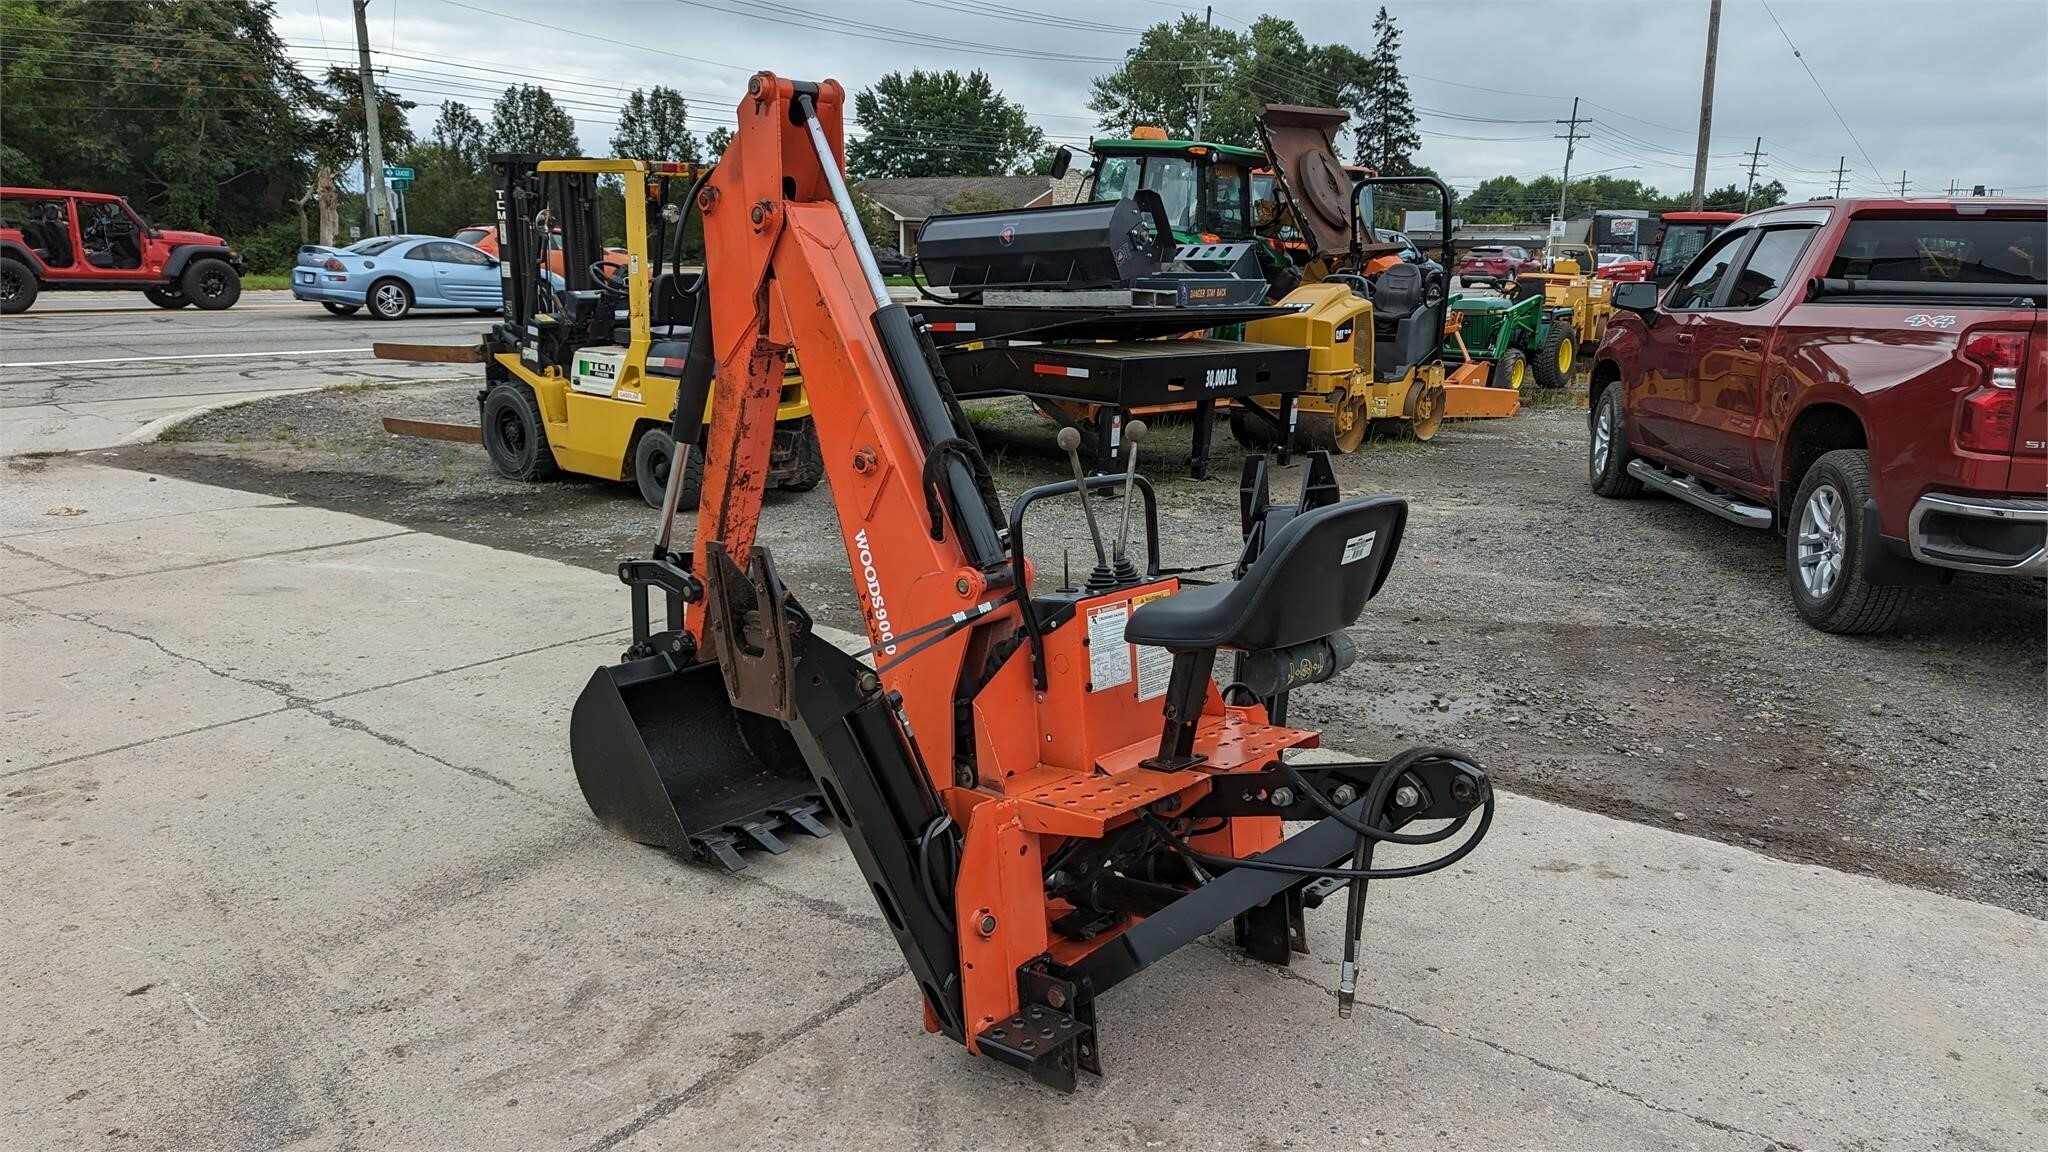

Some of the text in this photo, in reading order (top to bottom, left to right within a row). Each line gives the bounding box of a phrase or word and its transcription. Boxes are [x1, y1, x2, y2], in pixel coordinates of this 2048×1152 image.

[495, 189, 507, 220] TCM
[1190, 288, 1206, 299] DANGER
[1216, 287, 1227, 297] BACK
[590, 361, 616, 373] TCM
[1205, 369, 1227, 389] 30,000
